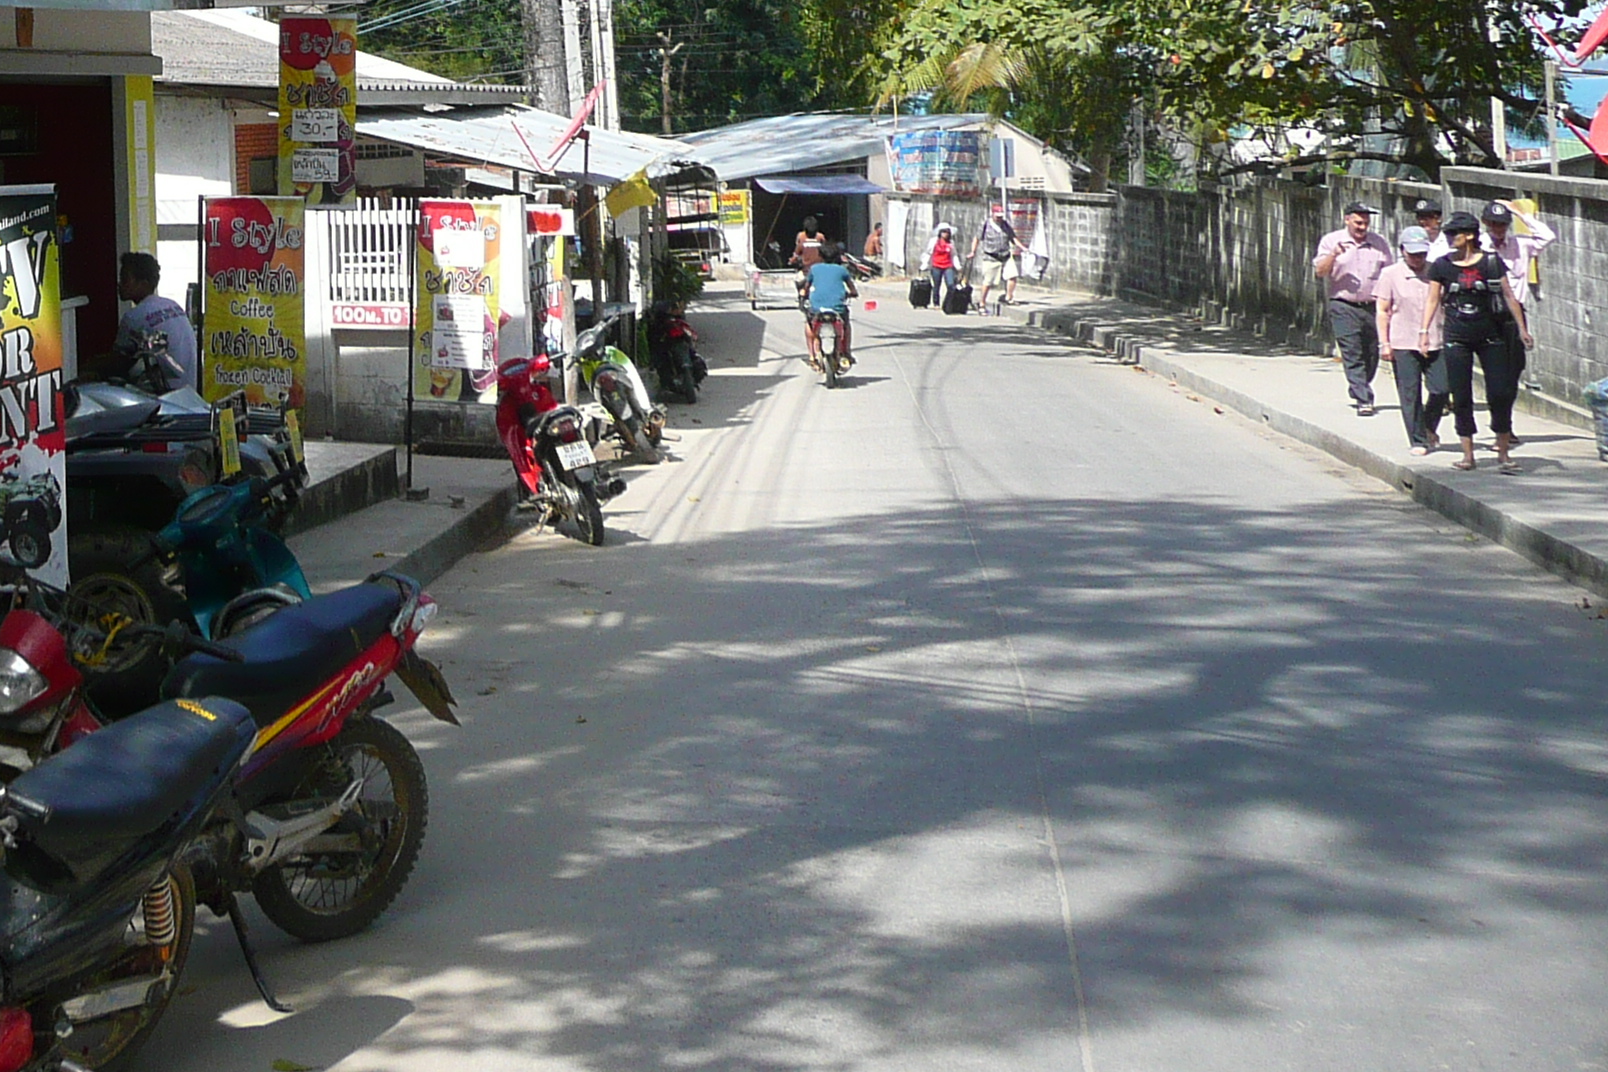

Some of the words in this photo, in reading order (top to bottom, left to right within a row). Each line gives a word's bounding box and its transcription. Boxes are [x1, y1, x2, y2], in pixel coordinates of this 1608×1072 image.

[282, 32, 291, 54] I
[299, 31, 353, 58] Style
[209, 217, 221, 247] I
[231, 215, 302, 254] Style
[422, 215, 432, 238] I
[212, 261, 298, 295] กาแฟสด
[230, 297, 275, 319] Coffee
[210, 320, 297, 360] เหล้าปั่น
